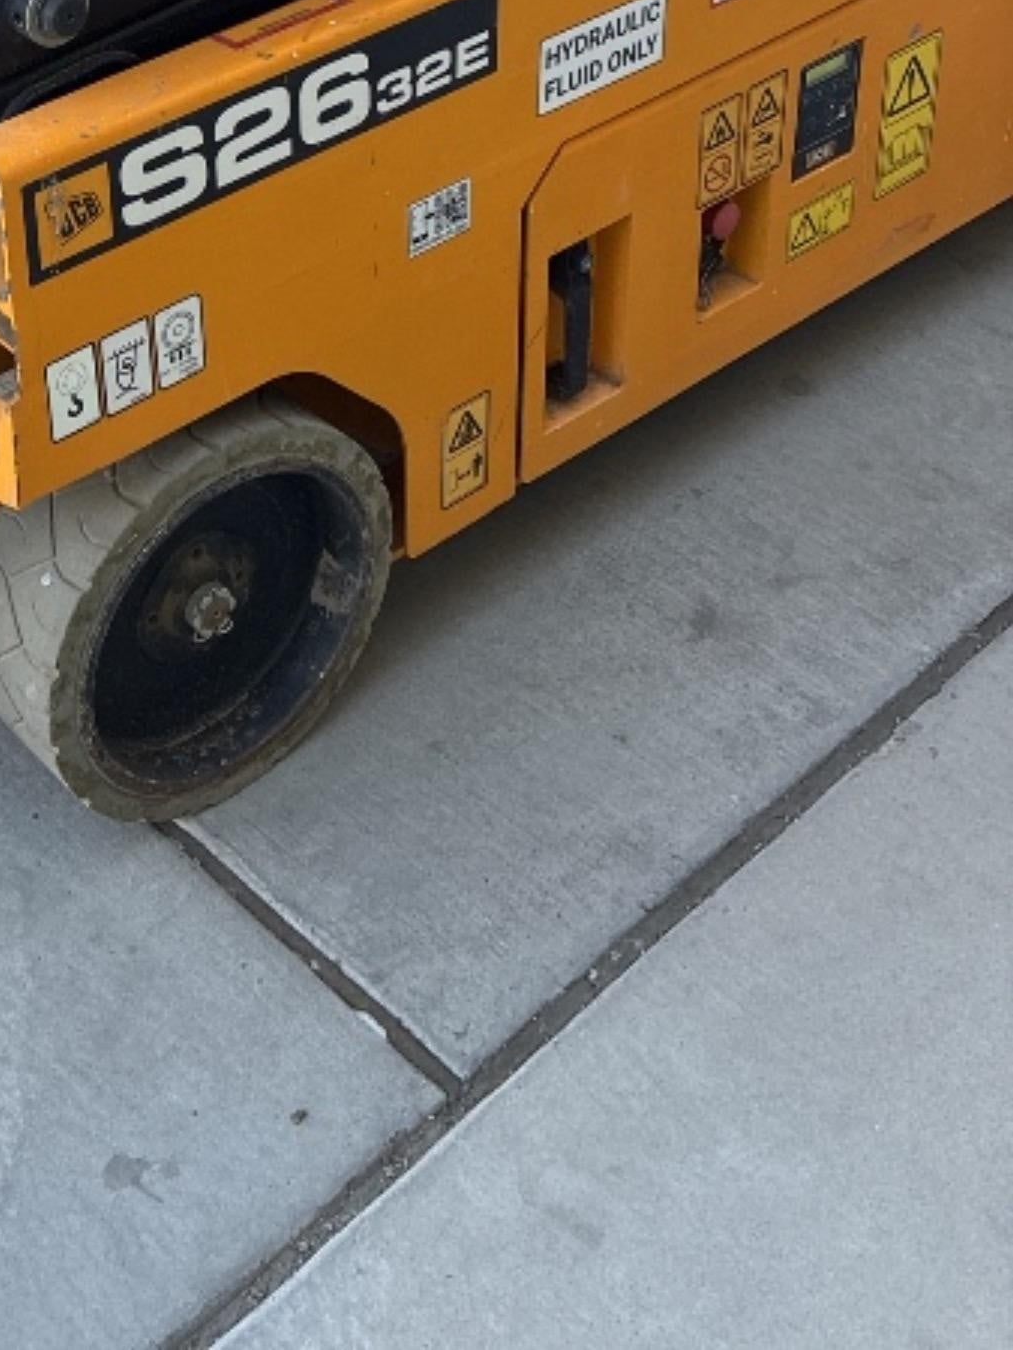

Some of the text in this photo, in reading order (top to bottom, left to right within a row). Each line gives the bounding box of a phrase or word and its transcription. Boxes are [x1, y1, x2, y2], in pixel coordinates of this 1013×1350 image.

[544, 0, 661, 70] HYDRAULIC
[544, 32, 659, 103] FLUID ONLY
